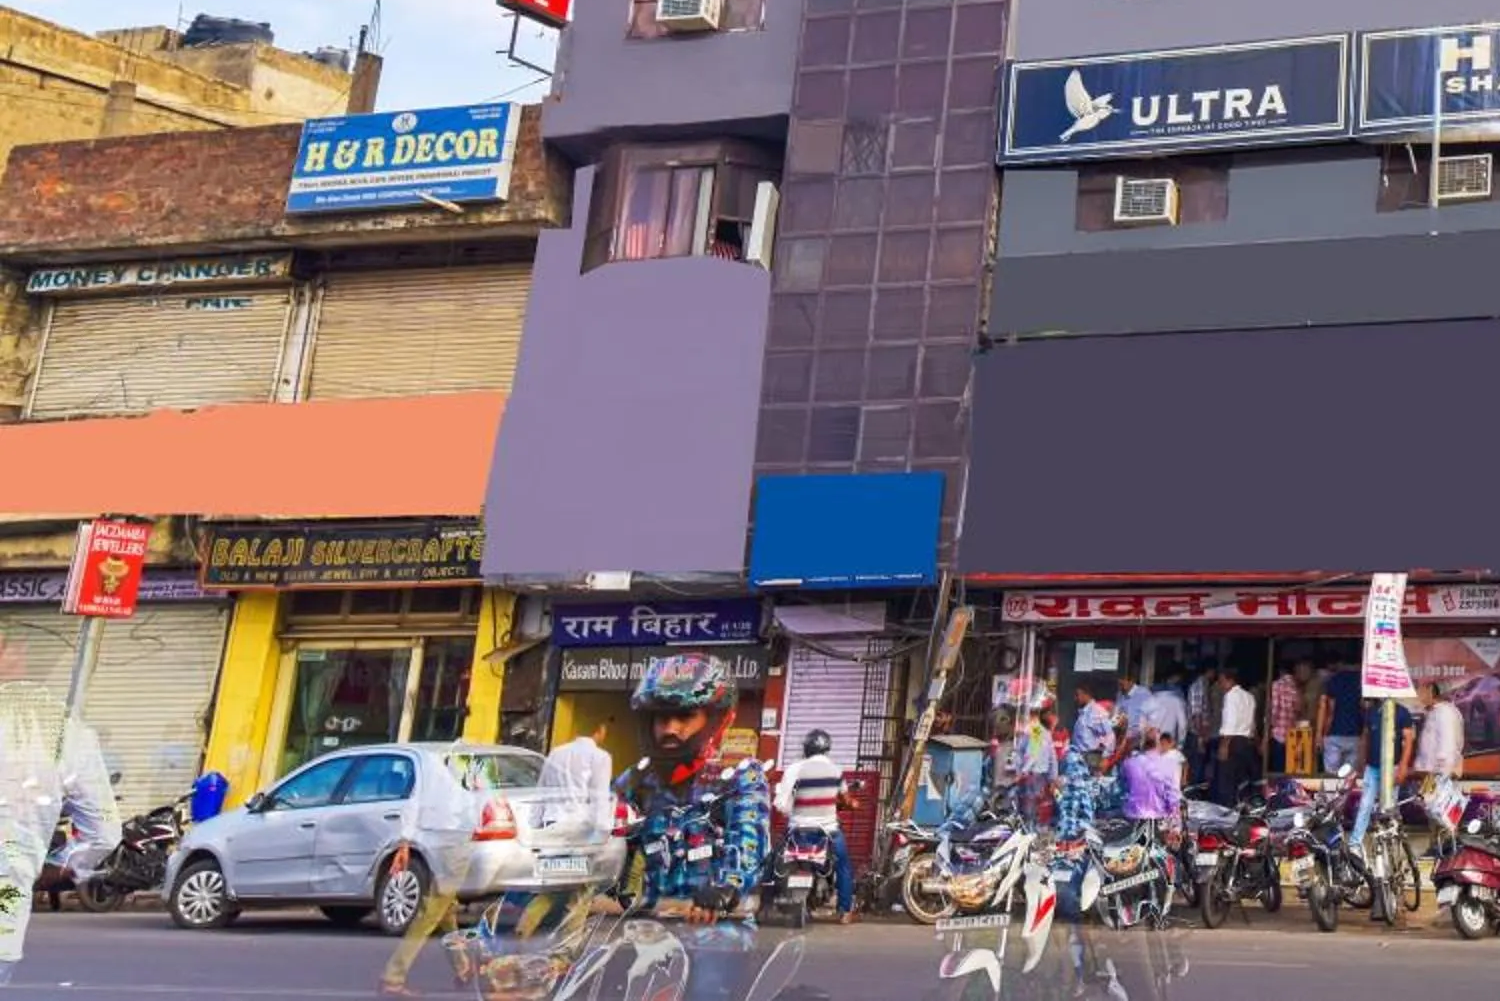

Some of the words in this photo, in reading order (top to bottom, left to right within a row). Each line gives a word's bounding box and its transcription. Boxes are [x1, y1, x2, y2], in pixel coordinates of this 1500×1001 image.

[1131, 85, 1287, 126] ULTRA
[303, 142, 329, 171] H
[333, 140, 361, 170] &
[363, 136, 386, 167] R
[391, 128, 499, 166] DECOR
[30, 265, 127, 290] MONEY
[212, 538, 304, 567] BALAJI
[311, 535, 484, 566] SILVERCRAFTS
[320, 568, 378, 581] JEWELLERY
[422, 566, 467, 578] OBJECTS
[561, 615, 618, 639] राम
